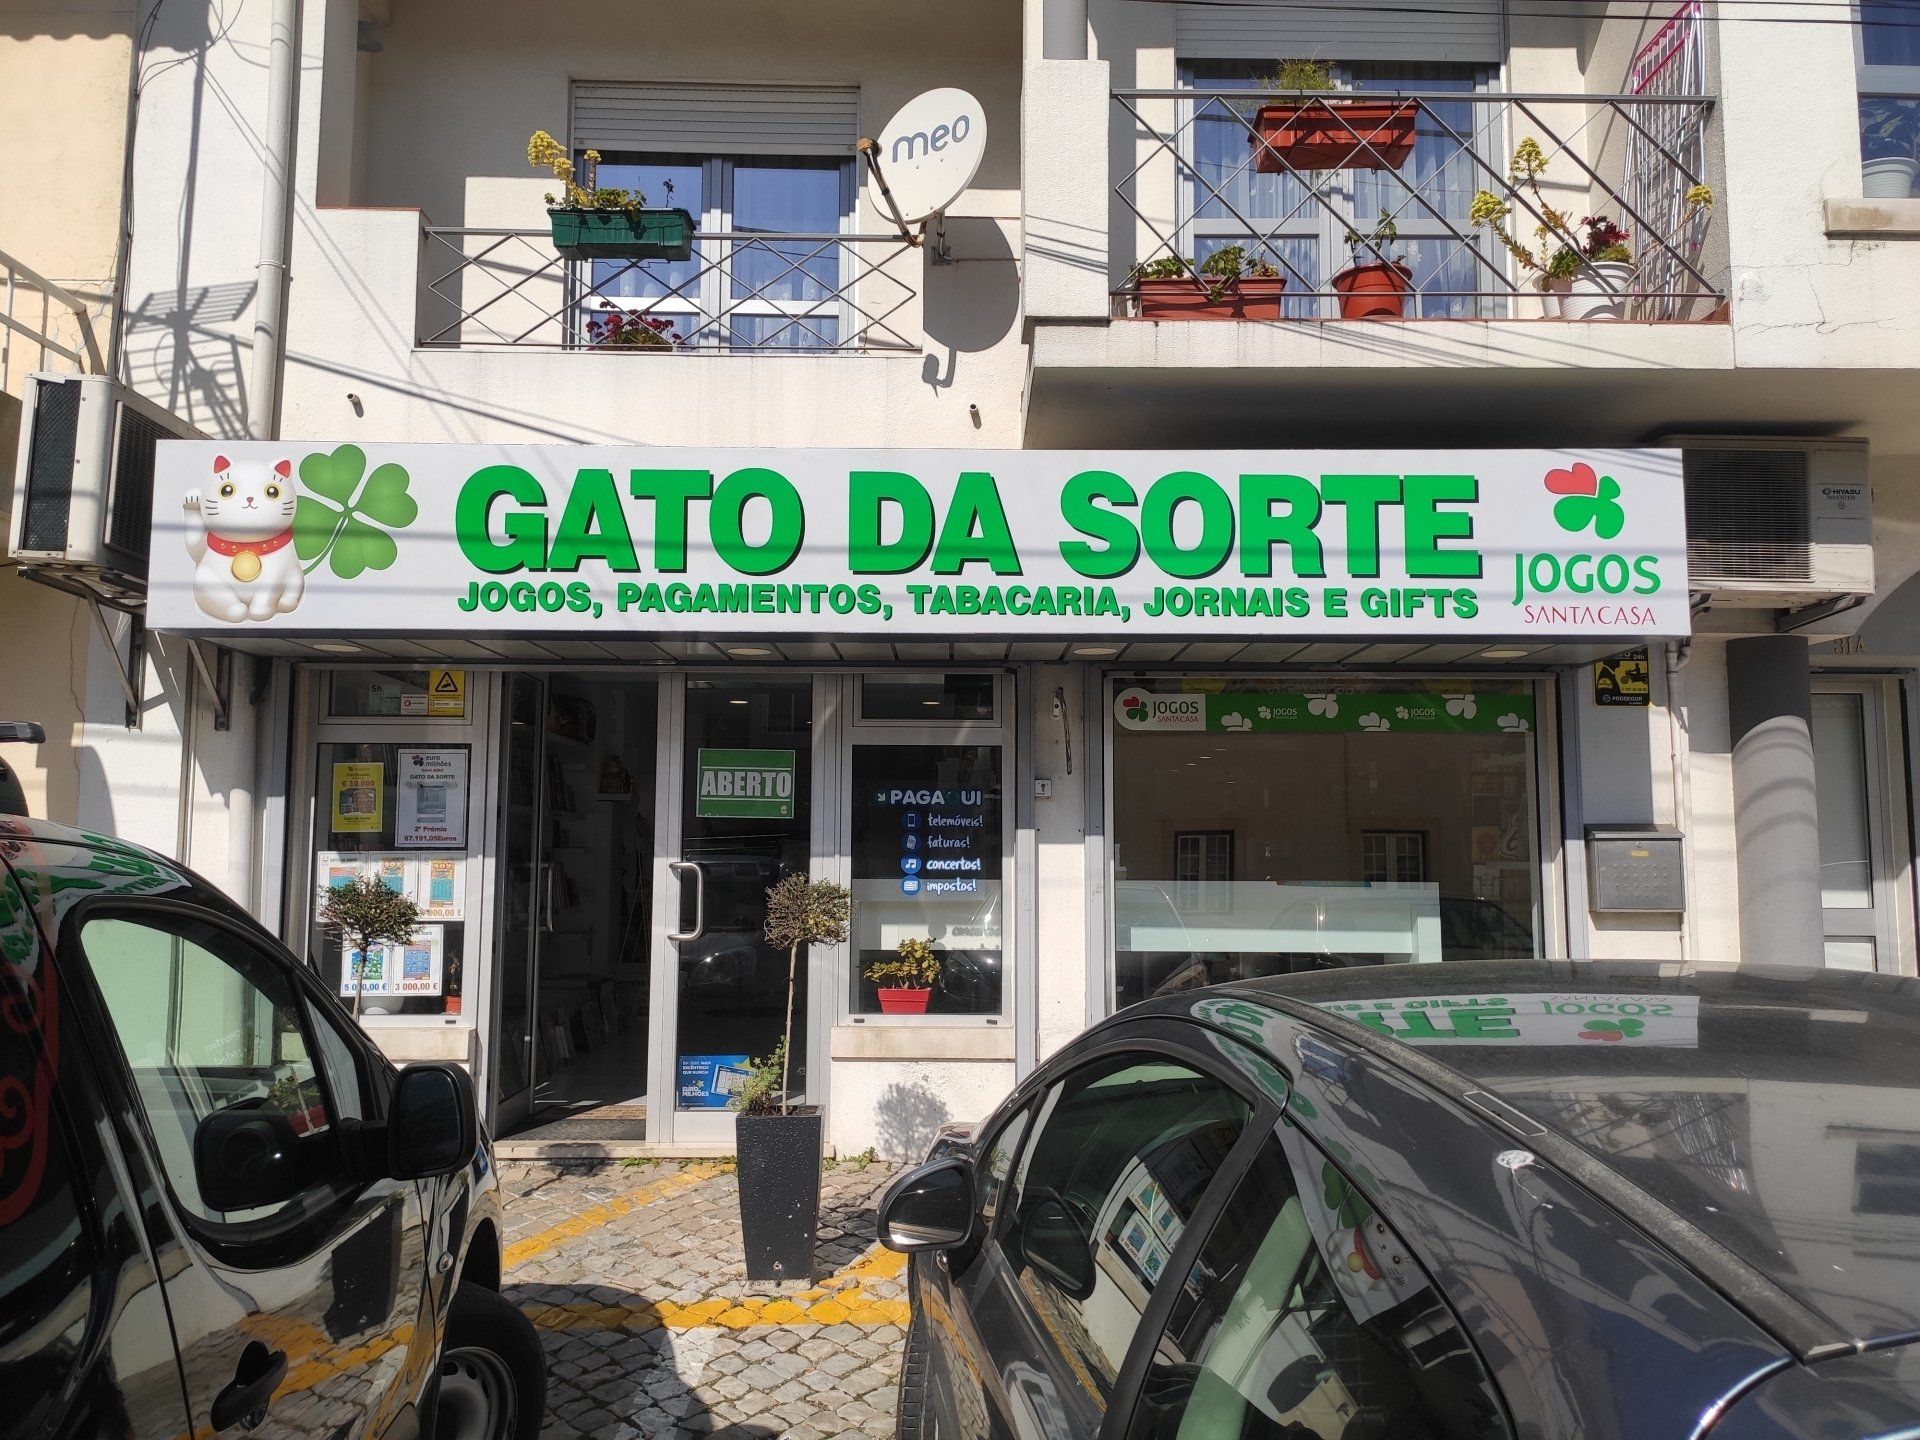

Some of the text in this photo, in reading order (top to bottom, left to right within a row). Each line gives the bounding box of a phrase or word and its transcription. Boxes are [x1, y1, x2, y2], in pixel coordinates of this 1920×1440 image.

[891, 114, 970, 163] meo
[455, 464, 1484, 580] GATO DA SORTE
[1511, 552, 1661, 606] JOGOS
[457, 580, 1479, 623] JOGOS, PAGAMENTOS, TABACARIA, JORNAIS E GIFTS
[1524, 604, 1657, 626] SANTACASA
[1152, 701, 1199, 718] JOGOS
[1272, 707, 1298, 718] JOGOS
[1410, 708, 1436, 717] JOGOS
[1157, 714, 1200, 723] SANTACASA
[701, 770, 792, 797] ABERTO
[890, 789, 982, 806] PAGAUI
[927, 812, 984, 827] telemóveis!
[926, 834, 970, 848] faturas!
[926, 855, 981, 870] concertos!
[926, 877, 977, 895] impostos!
[402, 982, 430, 992] 000,00
